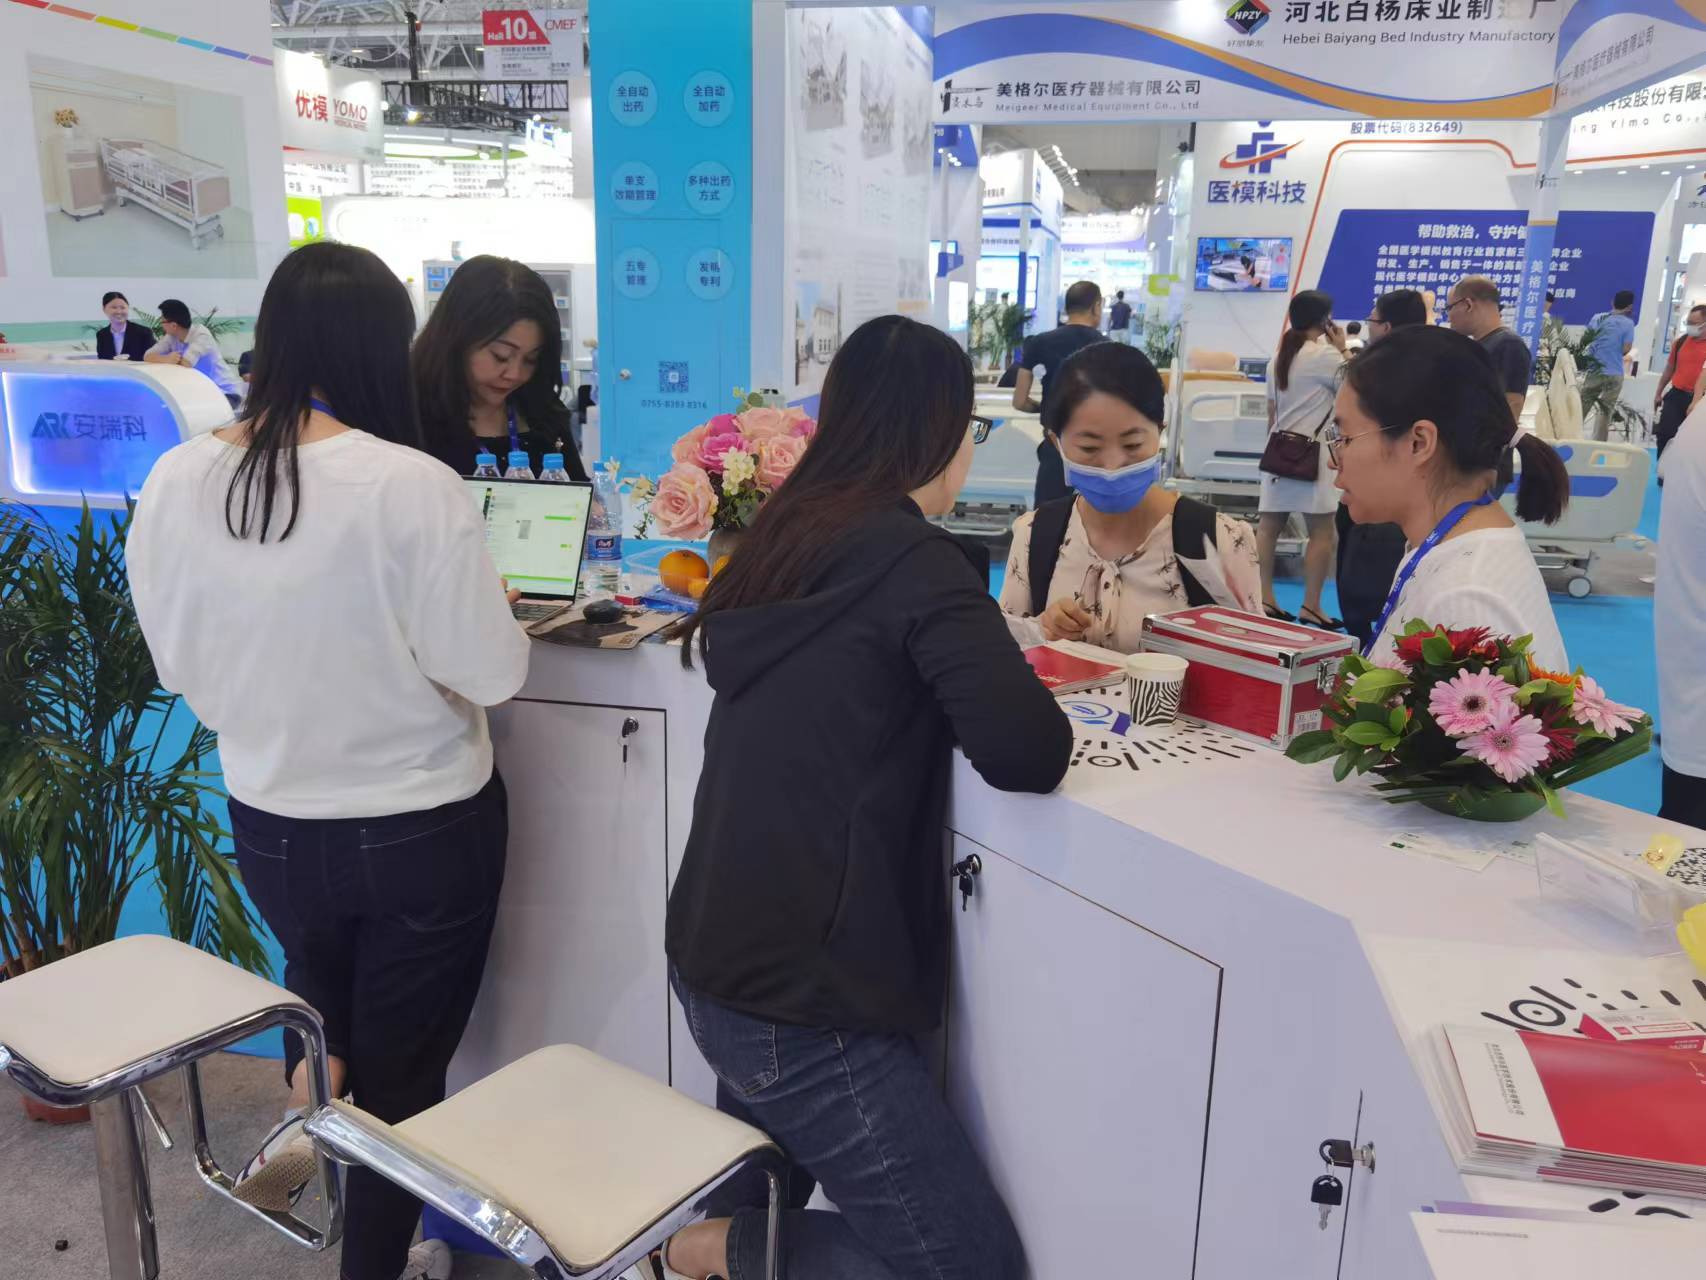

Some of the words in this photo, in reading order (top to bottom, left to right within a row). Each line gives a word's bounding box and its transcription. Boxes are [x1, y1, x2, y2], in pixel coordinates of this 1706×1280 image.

[1234, 10, 1261, 20] HPZY
[501, 16, 528, 40] 10
[1283, 33, 1320, 45] Hebei
[1324, 33, 1376, 46] Baiyang
[1381, 32, 1406, 43] Bed
[1410, 31, 1465, 44] Industry
[1469, 30, 1556, 44] Manufactory
[616, 86, 649, 97] 全自动
[693, 85, 726, 97] 全自动
[996, 79, 1201, 98] 美格尔医疗器械有限公司
[1590, 81, 1706, 113] 科技股份有限
[295, 90, 328, 122] 优模
[333, 98, 368, 121] YOMO
[623, 101, 644, 112] 出药
[699, 101, 720, 112] 加药
[996, 102, 1038, 113] Meigeer
[1043, 102, 1086, 112] Medical
[1181, 101, 1199, 110] Ltd
[1350, 121, 1463, 135] 股票代码(832649)
[688, 175, 731, 187] 多种出药
[699, 190, 720, 201] 方式
[1207, 180, 1307, 204] 医模科技
[699, 276, 721, 287] 专利
[73, 413, 148, 441] 安瑞科
